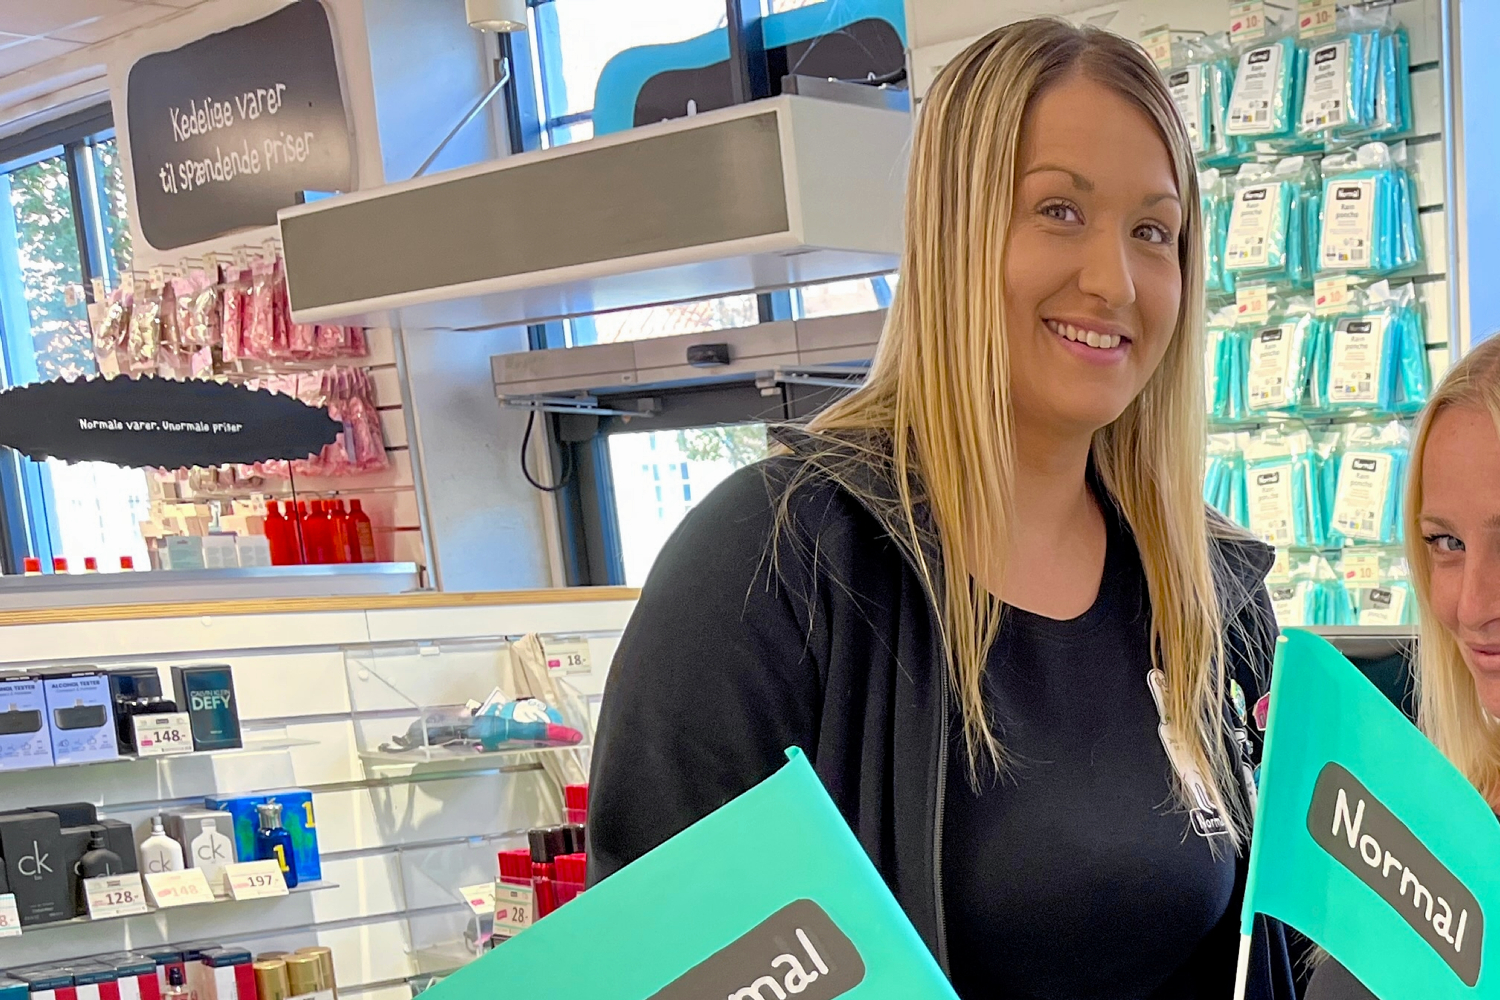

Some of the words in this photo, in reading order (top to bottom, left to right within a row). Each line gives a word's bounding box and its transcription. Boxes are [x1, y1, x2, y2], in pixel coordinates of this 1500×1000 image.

[170, 98, 233, 142] Kedelige
[235, 83, 286, 120] varer
[159, 162, 178, 194] til
[179, 139, 261, 191] spændende
[264, 131, 313, 171] priser
[78, 419, 123, 430] Normale
[126, 421, 160, 431] varer.
[162, 421, 209, 432] Unormale
[212, 422, 243, 434] priser
[192, 696, 231, 711] DEFY
[302, 802, 316, 828] 1
[18, 841, 53, 876] ck
[197, 835, 226, 860] ck
[273, 844, 289, 872] 1
[149, 852, 171, 873] ck
[1331, 787, 1468, 954] Normal
